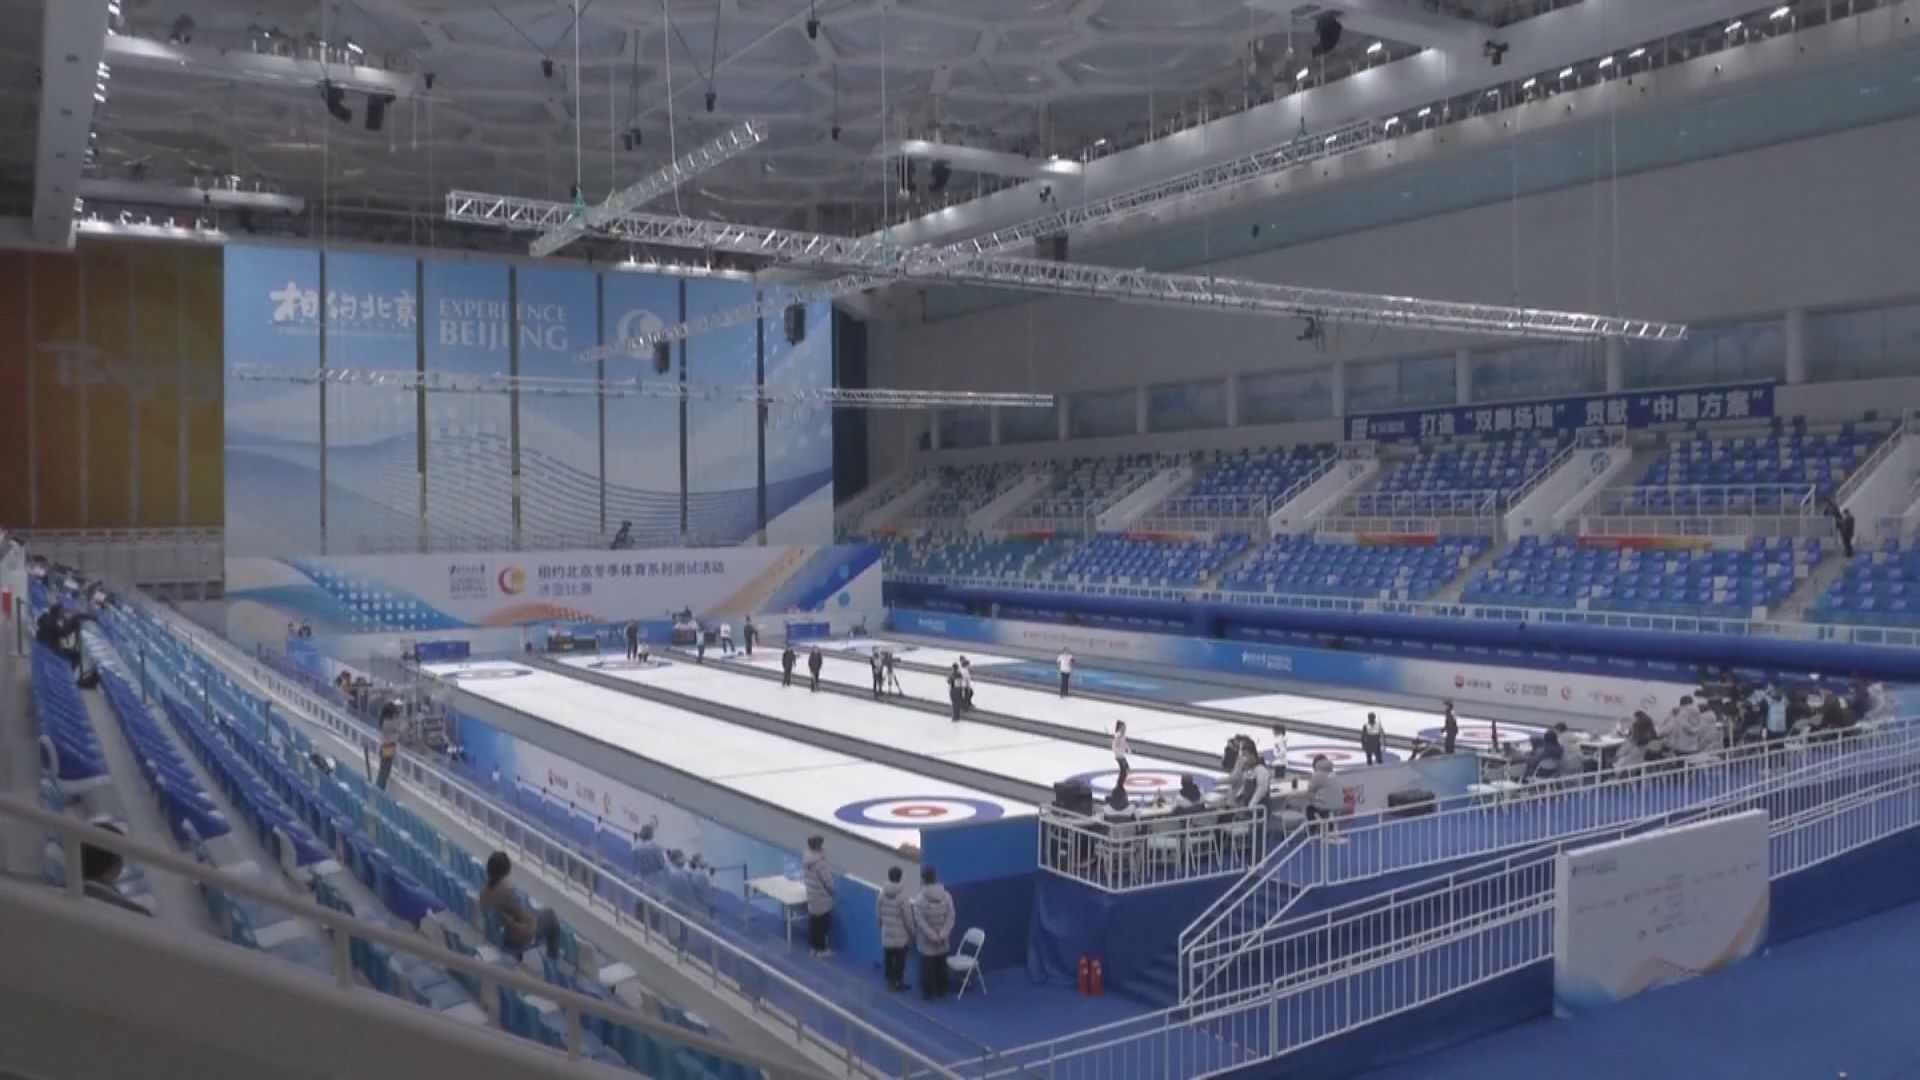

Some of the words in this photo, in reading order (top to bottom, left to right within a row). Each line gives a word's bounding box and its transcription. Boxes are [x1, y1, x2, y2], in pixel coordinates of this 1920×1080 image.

[269, 280, 416, 328] 相约北京
[439, 299, 568, 323] EXPERIENCE
[439, 320, 568, 351] BEIJING
